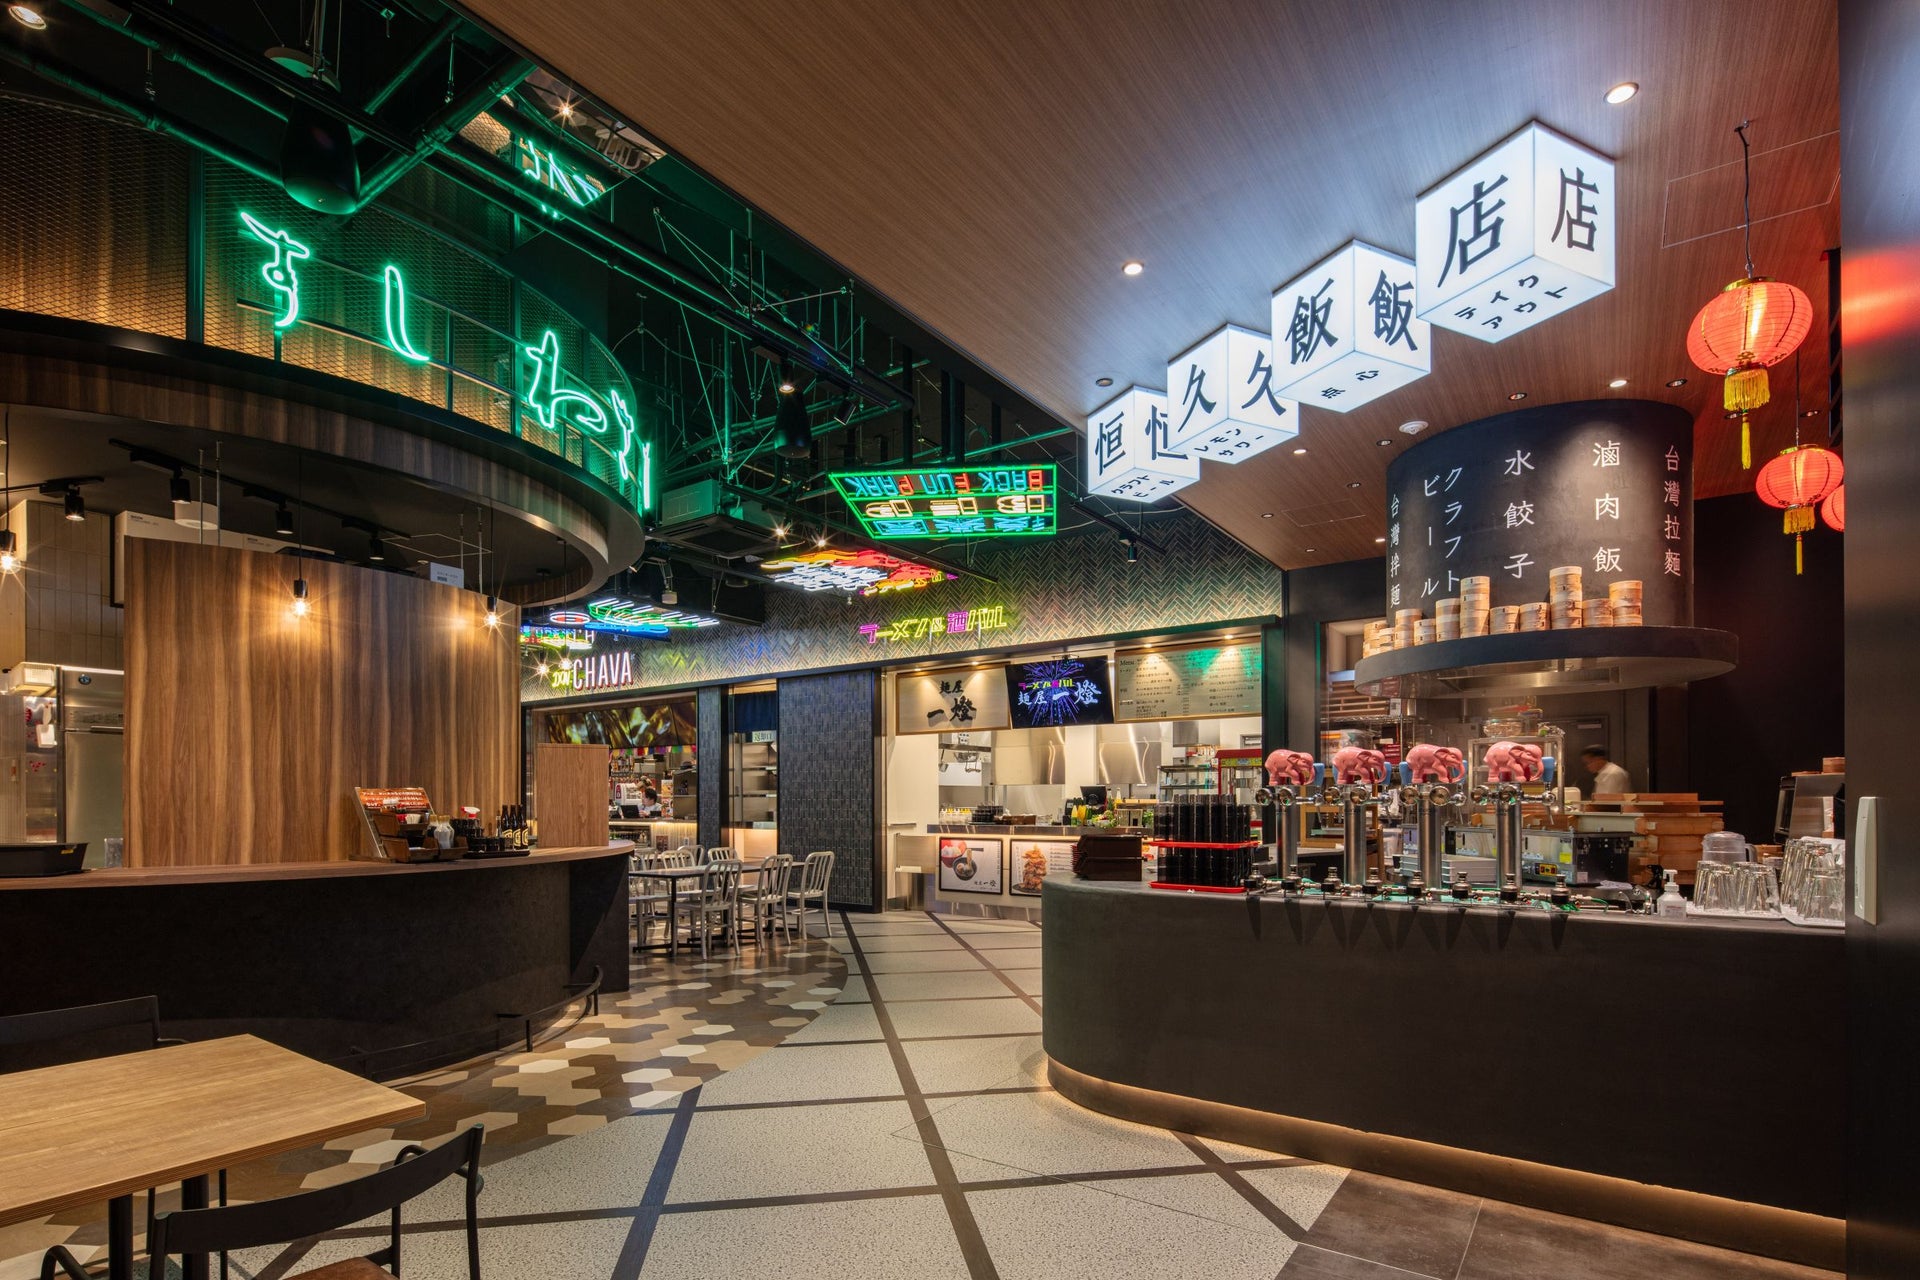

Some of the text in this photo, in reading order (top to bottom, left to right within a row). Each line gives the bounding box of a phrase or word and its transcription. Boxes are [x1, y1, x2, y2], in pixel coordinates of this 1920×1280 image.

[1438, 174, 1509, 288] 店
[1551, 167, 1600, 252] 店
[1286, 278, 1338, 365] 飯
[1369, 270, 1418, 352] 飯
[1454, 275, 1539, 320] テイク
[1481, 287, 1568, 330] アウト
[1178, 363, 1217, 433] 久
[1241, 350, 1287, 416] 久
[1321, 369, 1380, 399] 点心
[1095, 411, 1126, 477] 恒
[1194, 427, 1242, 452] レモン
[1218, 434, 1265, 457] サワー
[1111, 475, 1150, 495] クラフト
[1133, 479, 1175, 498] ビール
[1503, 450, 1535, 580] 水餃子
[1592, 440, 1623, 574] 滷肉飯
[1421, 475, 1441, 599] ビール
[1444, 467, 1464, 592] クラフト
[573, 652, 634, 691] CHAVA
